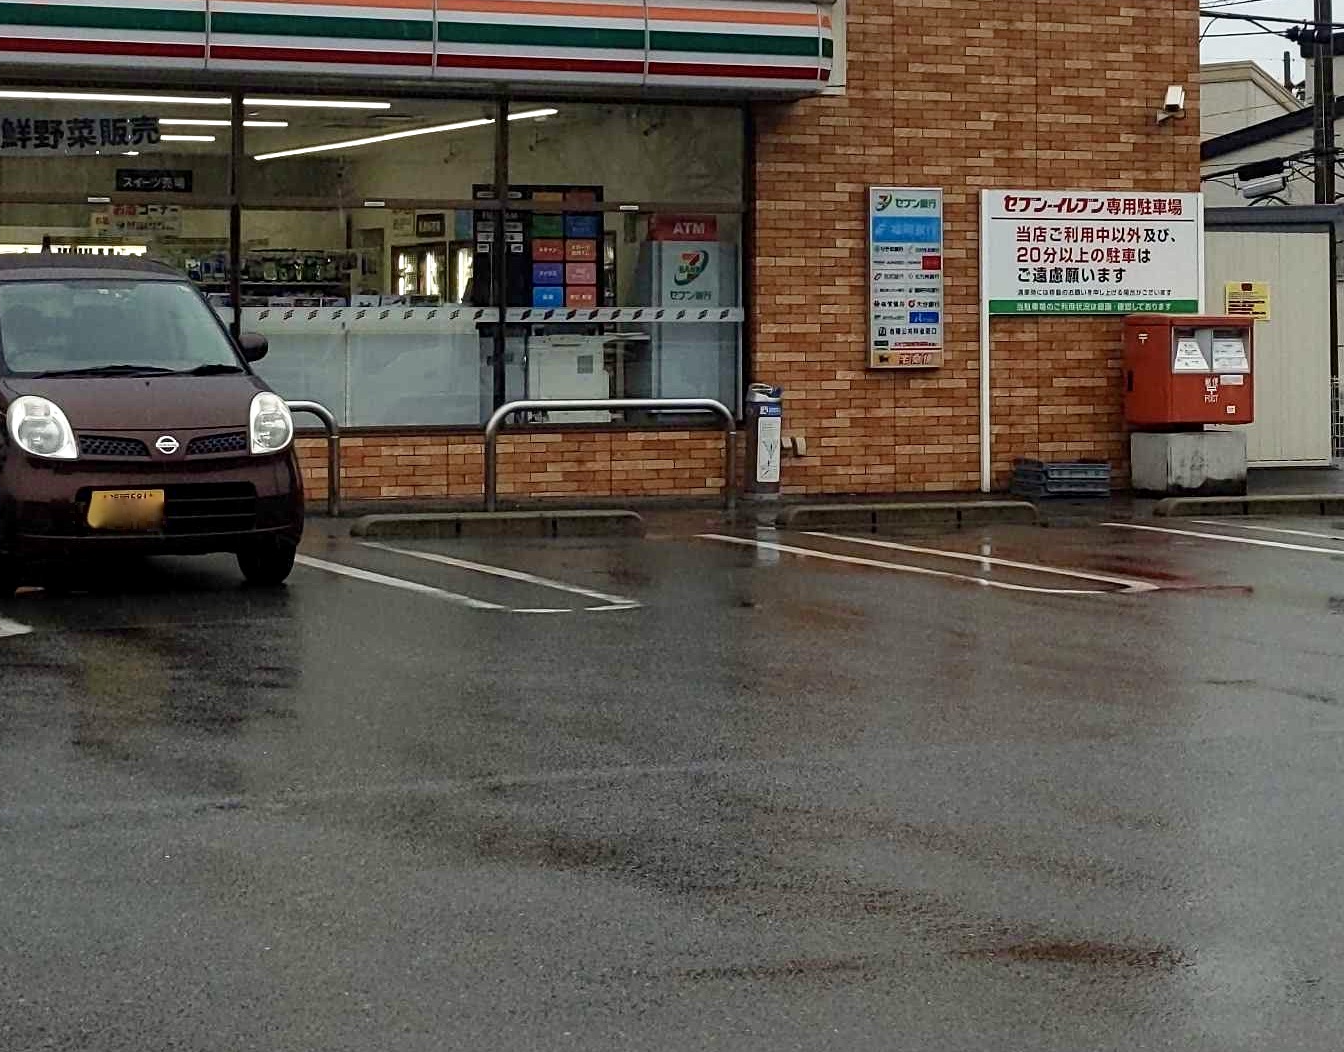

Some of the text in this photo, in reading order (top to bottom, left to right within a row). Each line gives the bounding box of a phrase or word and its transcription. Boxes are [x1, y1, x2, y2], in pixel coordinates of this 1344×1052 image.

[895, 198, 937, 209] セブン銀行
[672, 222, 705, 235] ATM
[1015, 225, 1176, 244] 当店ご利用中以外及び、
[1016, 246, 1151, 264] 20分以上の駐車は
[1017, 267, 1127, 284] ご遠慮願います
